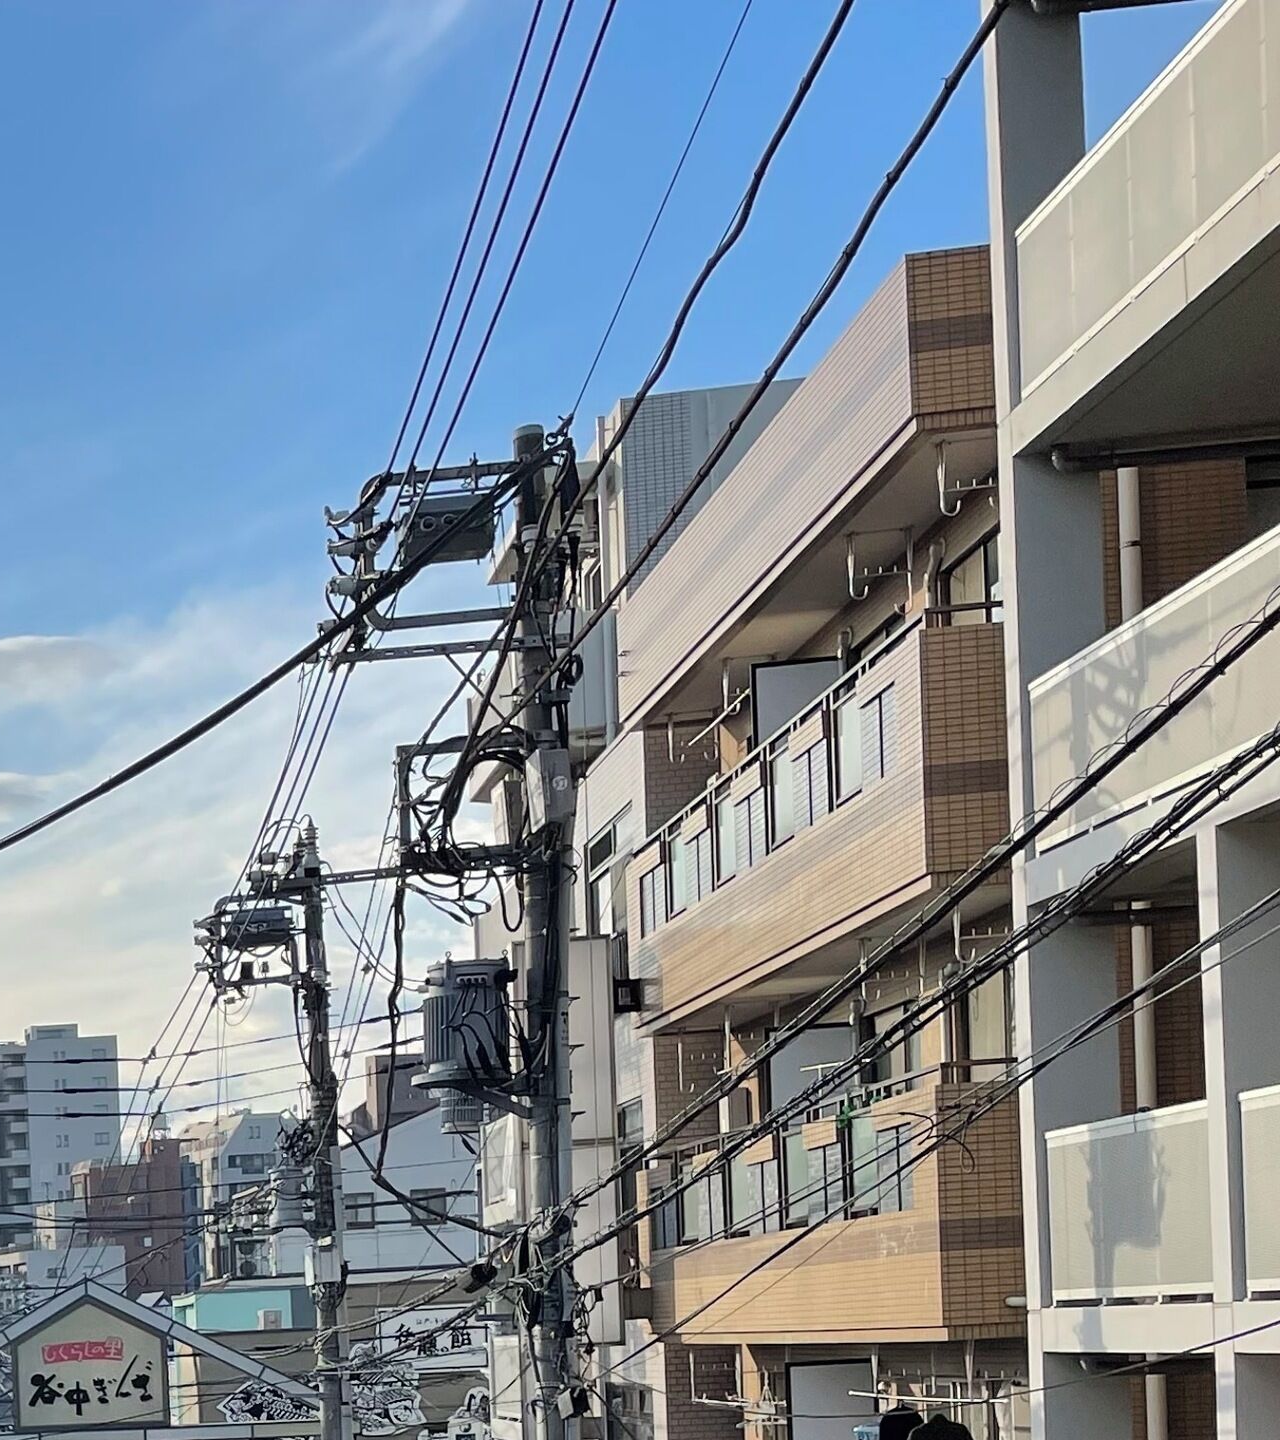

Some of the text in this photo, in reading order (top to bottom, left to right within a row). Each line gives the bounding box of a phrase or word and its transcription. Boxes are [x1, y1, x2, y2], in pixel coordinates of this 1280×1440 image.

[28, 1354, 154, 1416] 谷中ぎんざ
